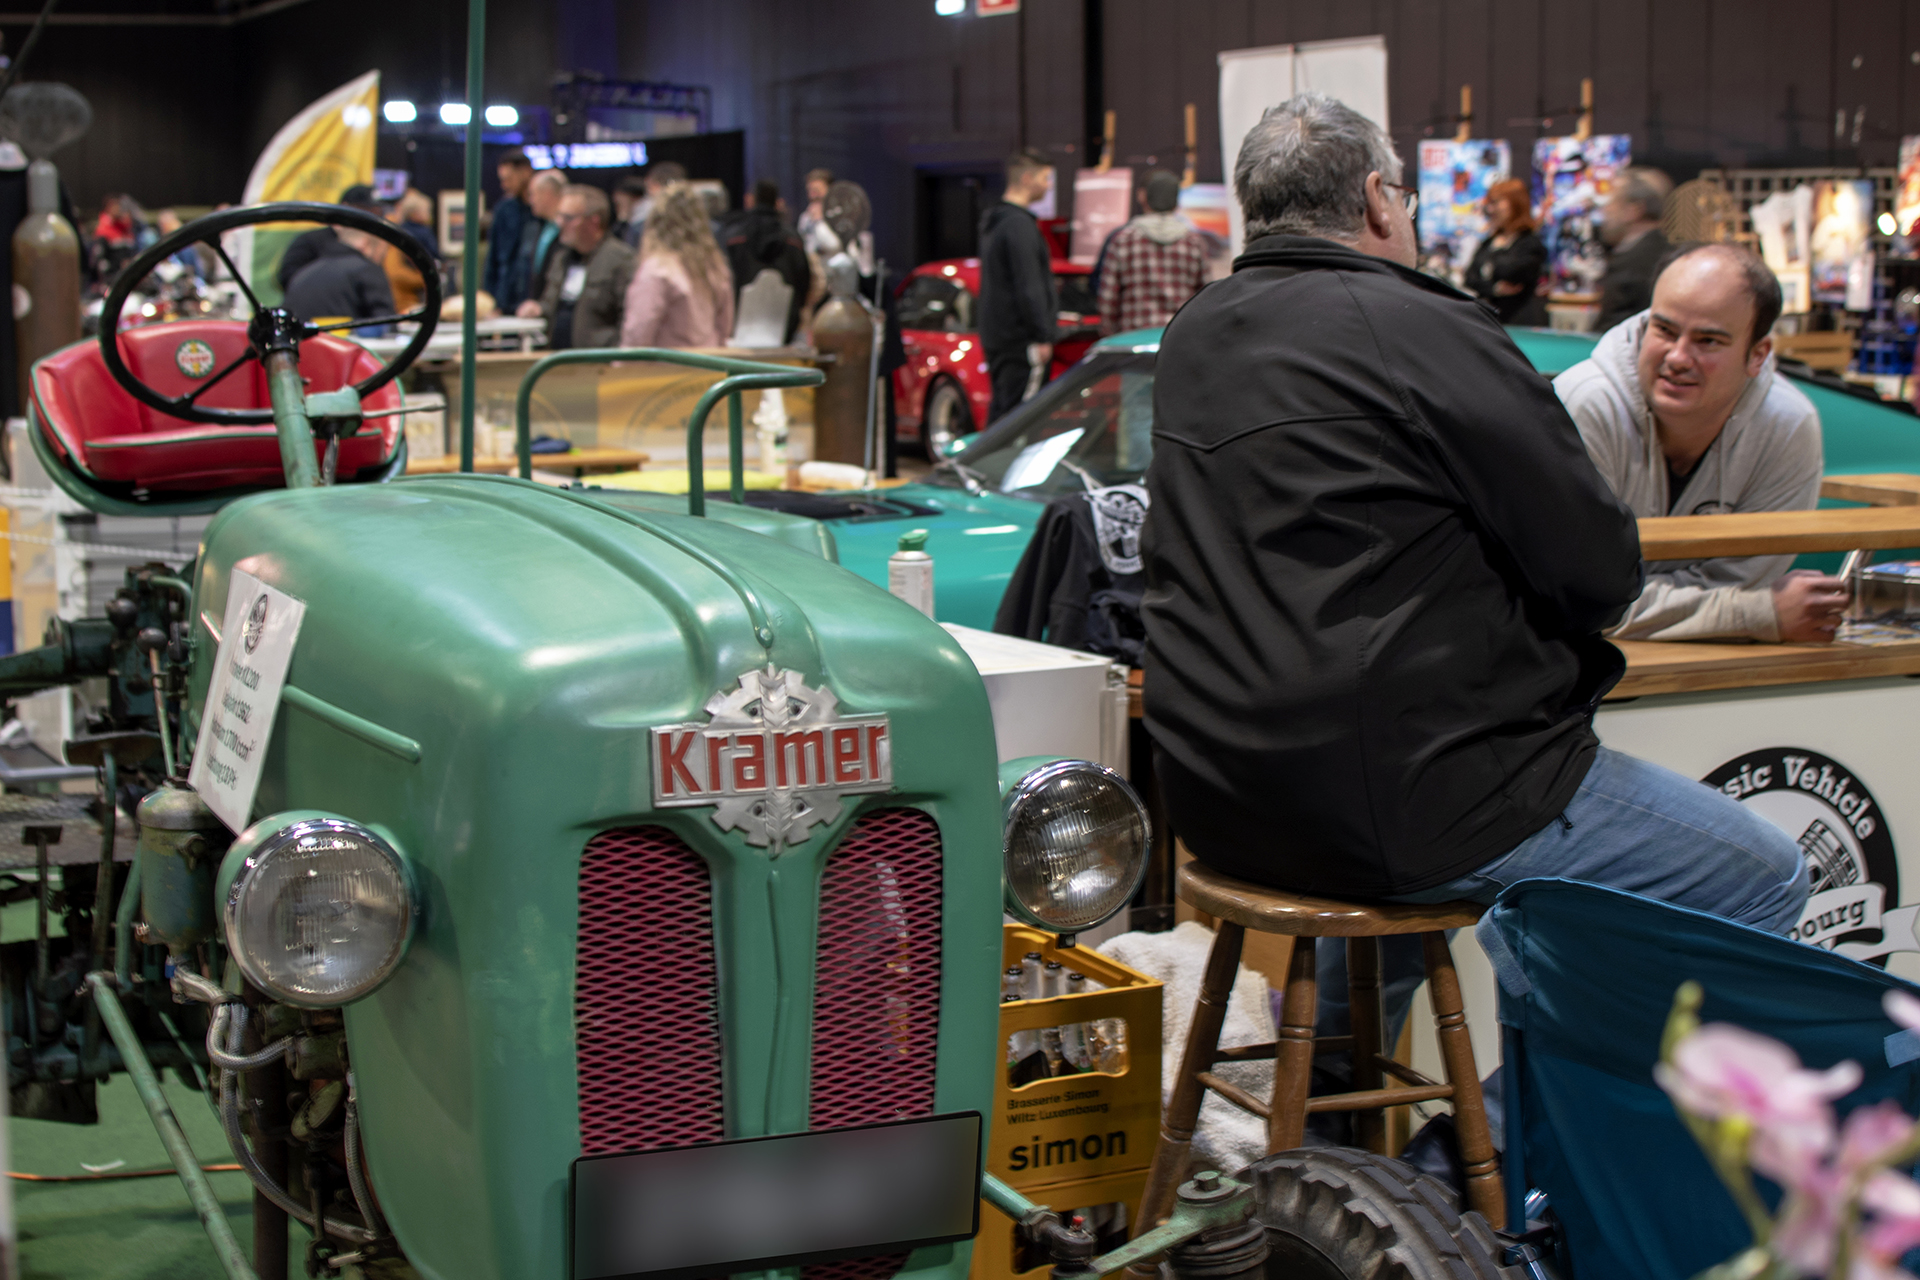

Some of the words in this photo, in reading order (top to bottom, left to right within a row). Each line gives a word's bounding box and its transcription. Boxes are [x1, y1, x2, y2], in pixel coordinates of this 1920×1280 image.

[657, 724, 889, 798] Kramer
[1717, 763, 1773, 799] sic
[1782, 755, 1876, 840] Vehicle
[1006, 1113, 1037, 1125] Wiltz
[1039, 1102, 1110, 1120] Luxembourg
[1007, 1095, 1060, 1110] Brasserie
[1063, 1089, 1100, 1102] Simon
[1008, 1130, 1127, 1172] simon
